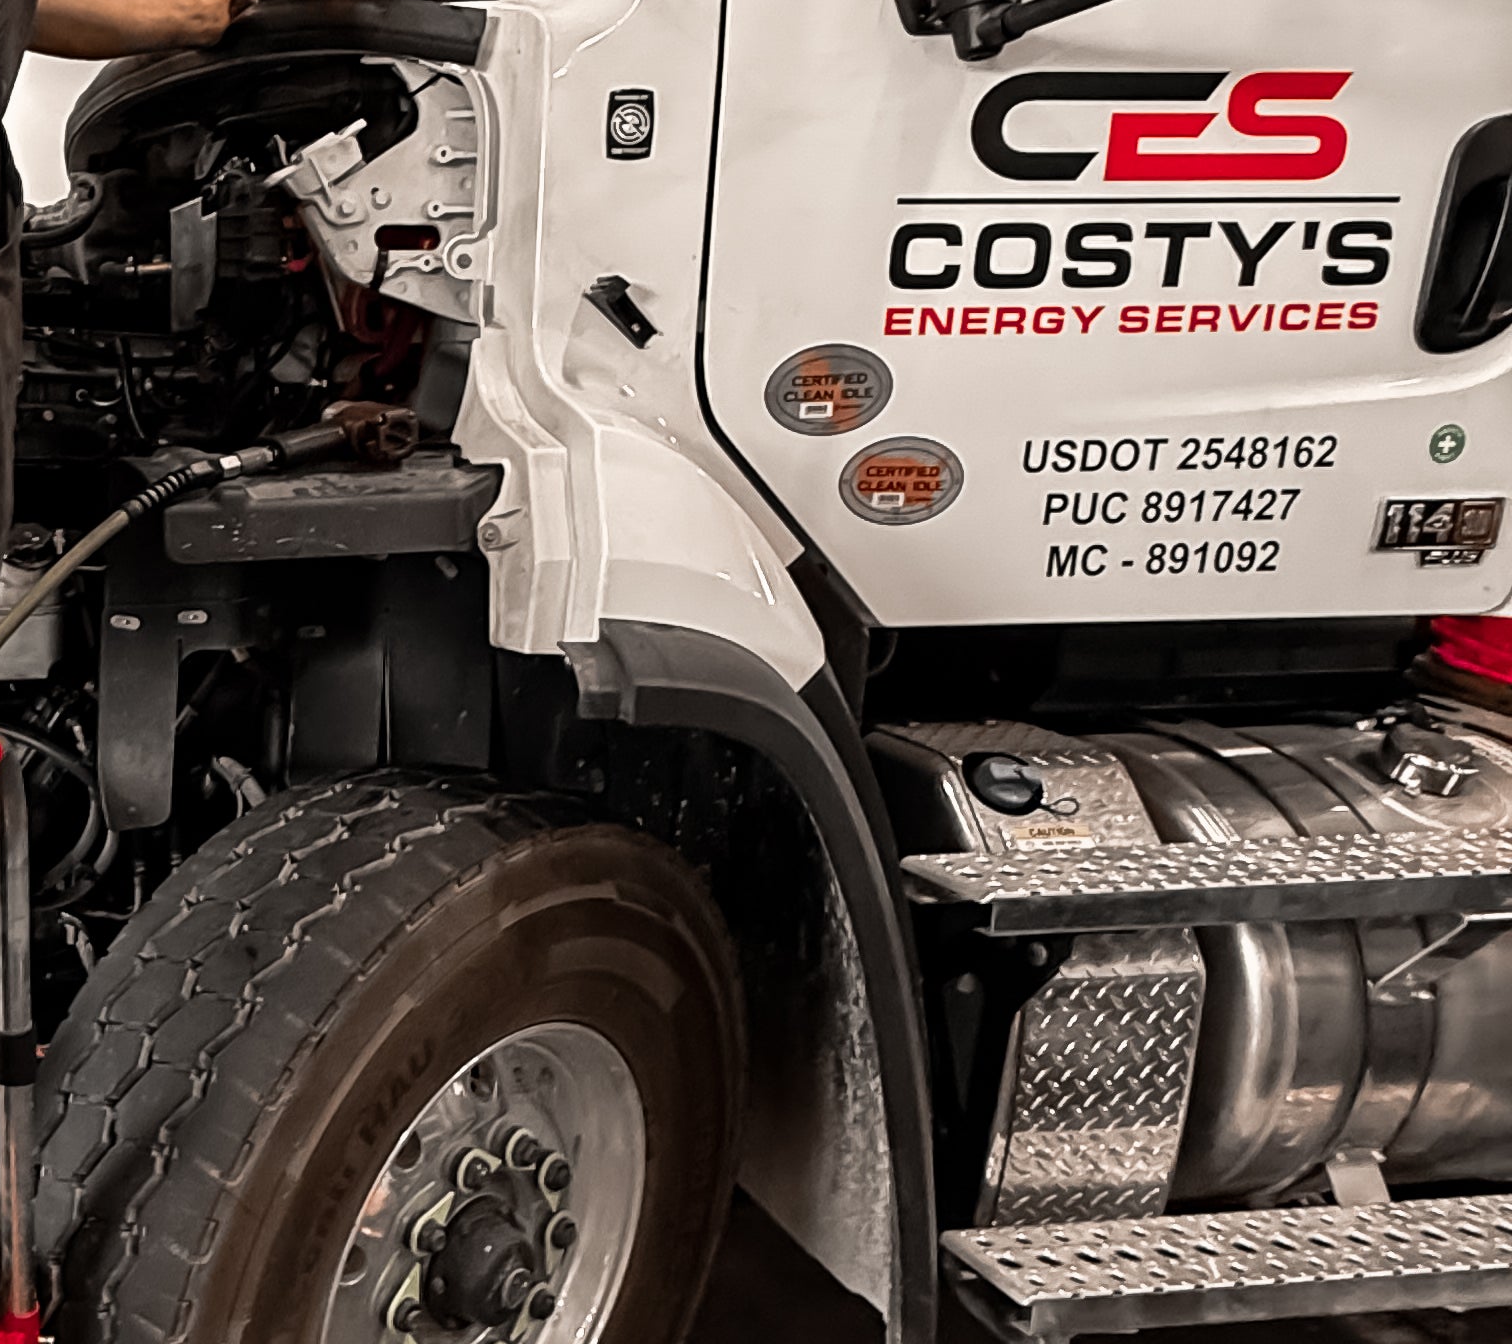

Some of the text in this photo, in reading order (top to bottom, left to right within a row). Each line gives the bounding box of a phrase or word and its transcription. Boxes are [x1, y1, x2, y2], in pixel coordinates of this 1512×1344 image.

[970, 71, 1355, 181] CES
[888, 220, 1394, 290] COSTY'S
[884, 301, 1380, 336] ENERGY SERVICES
[783, 387, 874, 403] CLEAN IDLE
[791, 372, 868, 387] CERTIFIED
[866, 465, 940, 478] CERTIFIED
[1022, 434, 1338, 474] USDOT 2548162
[857, 480, 944, 492] CLEAN IDLE
[1042, 488, 1301, 526] PUC 8917427
[1045, 543, 1109, 578] MC
[1145, 540, 1280, 575] 891092
